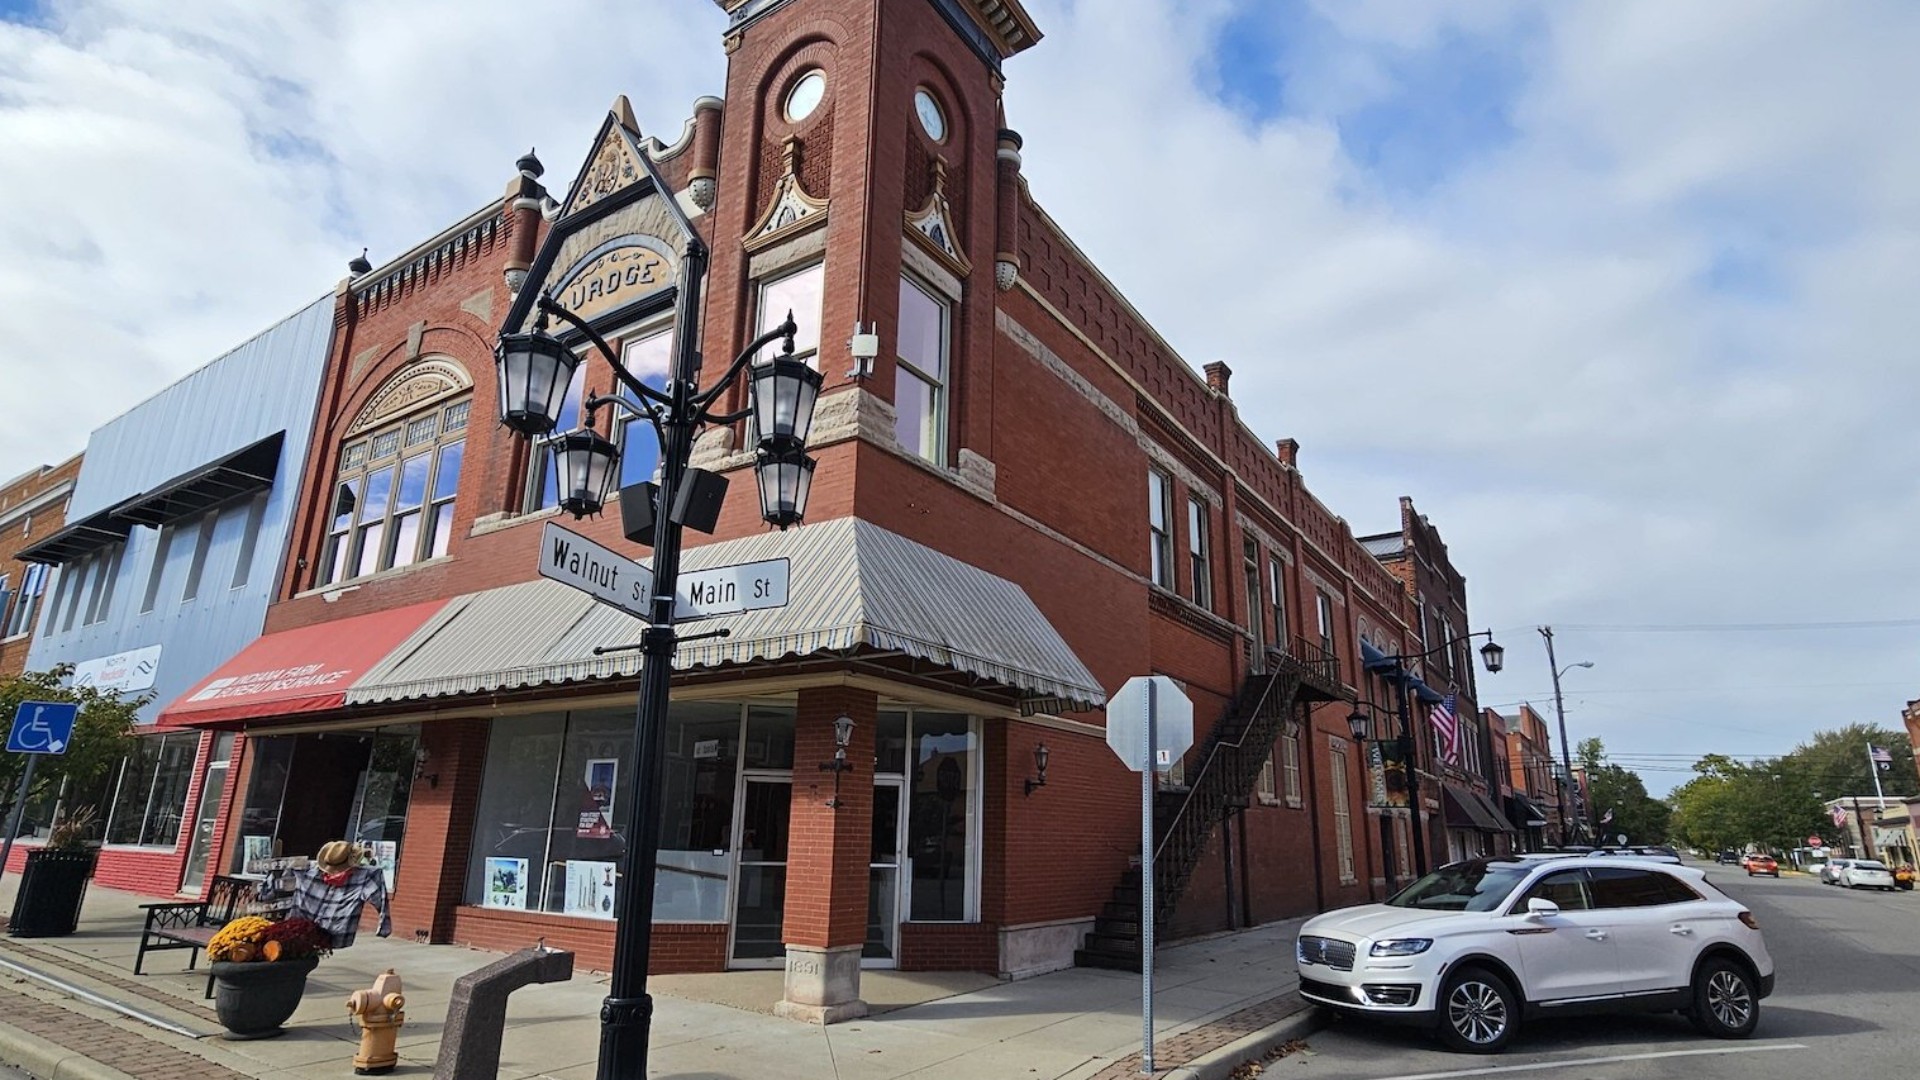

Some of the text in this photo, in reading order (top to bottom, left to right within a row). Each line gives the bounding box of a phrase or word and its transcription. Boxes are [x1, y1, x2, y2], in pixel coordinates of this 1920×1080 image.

[555, 260, 660, 325] URDGE
[553, 537, 646, 604] Walnut St
[690, 578, 771, 607] Main St
[214, 670, 352, 699] BUREAU INSURANCE
[231, 663, 325, 685] INDIANA FARM
[1371, 747, 1385, 802] WELCOME
[246, 900, 292, 912] Harves
[789, 960, 819, 975] 1891
